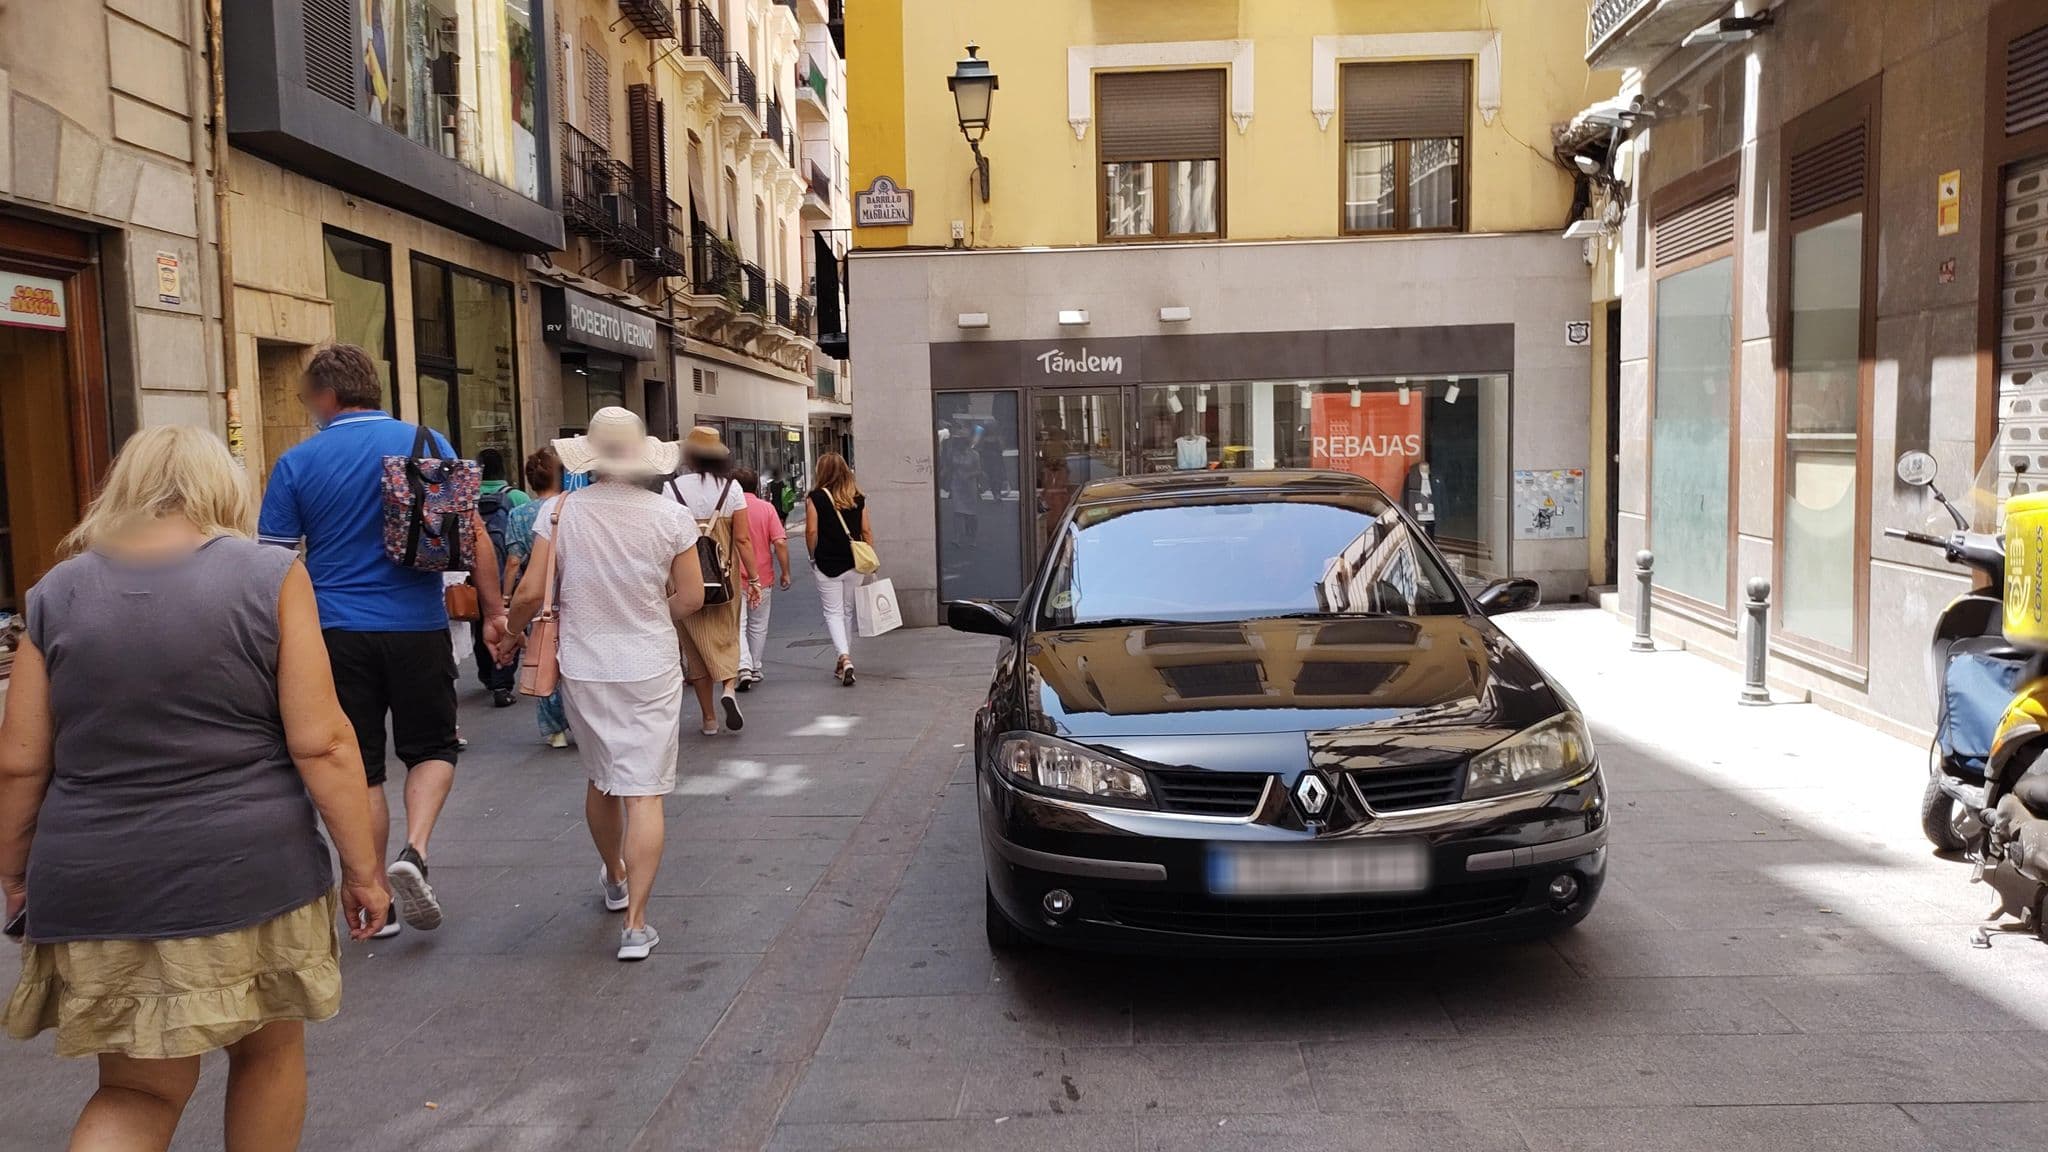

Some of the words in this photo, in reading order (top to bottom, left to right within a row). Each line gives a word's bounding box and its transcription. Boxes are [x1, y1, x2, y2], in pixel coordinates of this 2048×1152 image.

[862, 209, 907, 220] MAGDALENA
[546, 324, 563, 332] RV
[570, 303, 621, 341] ROBERTO
[620, 321, 654, 350] VERINO
[1036, 346, 1123, 375] Tándem
[1312, 434, 1421, 459] REBAJAS
[2034, 524, 2043, 623] CORREOS
